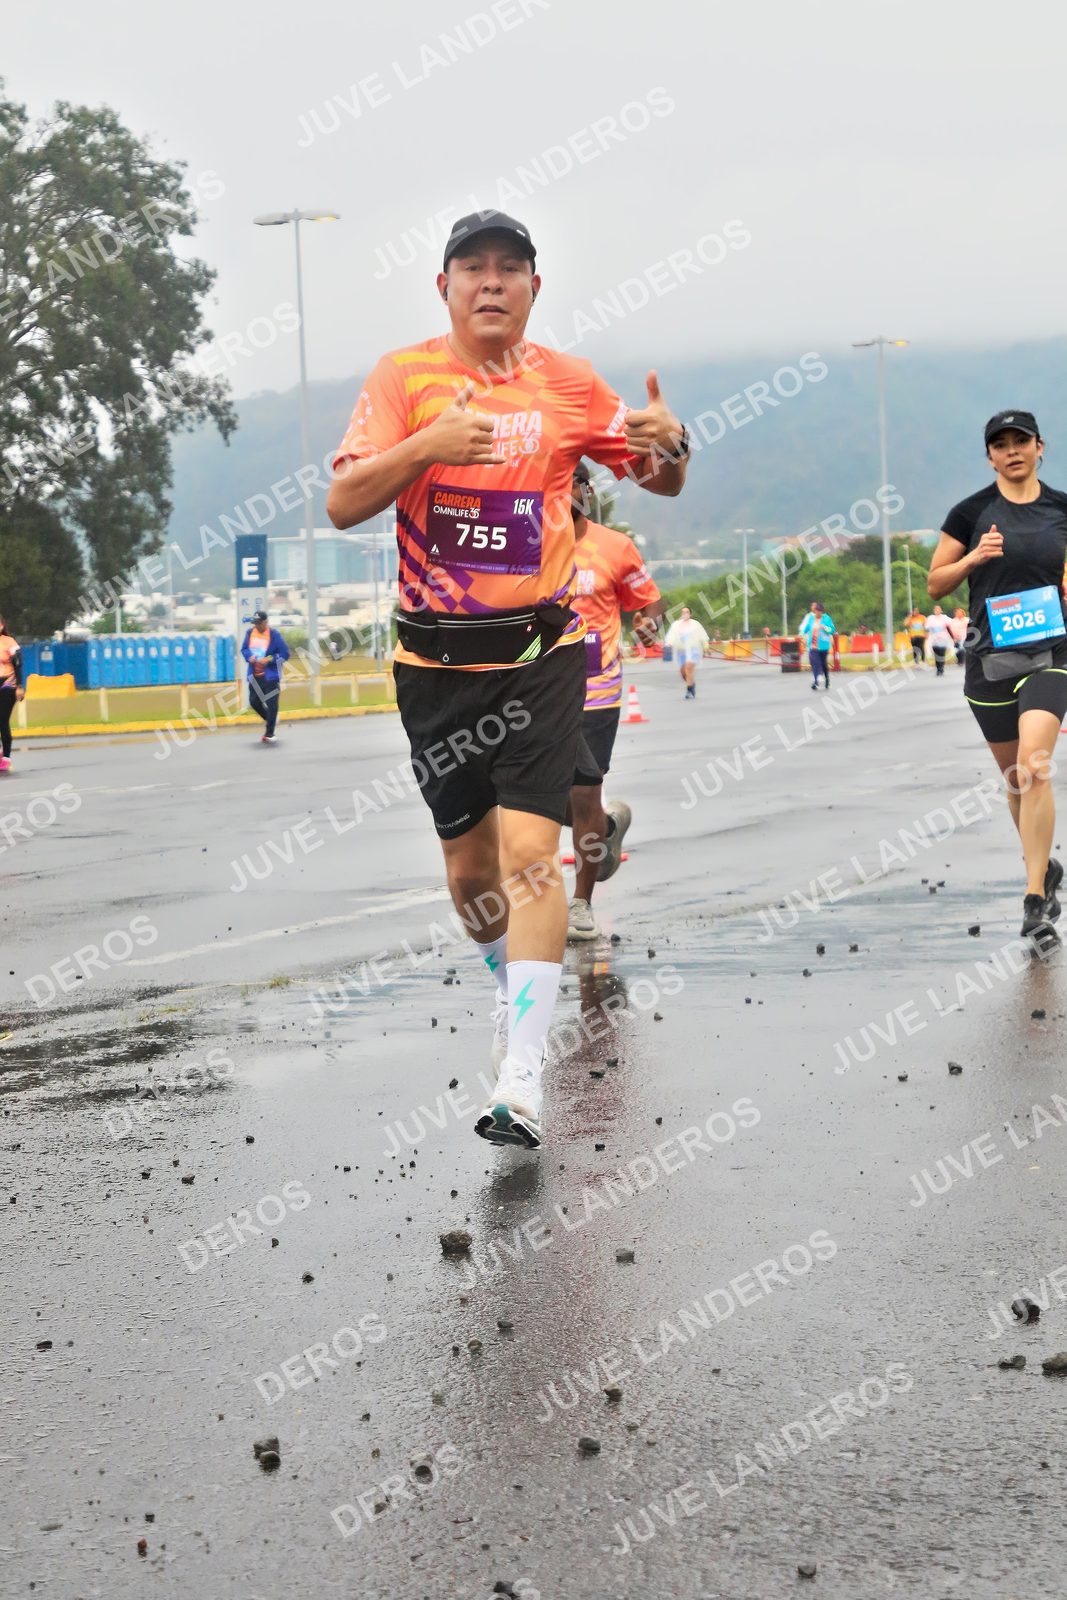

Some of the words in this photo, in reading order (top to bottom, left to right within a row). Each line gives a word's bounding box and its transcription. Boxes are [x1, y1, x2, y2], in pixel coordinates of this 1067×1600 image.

[434, 491, 482, 508] CARRERA
[456, 523, 507, 550] 755
[241, 557, 259, 581] E
[1001, 609, 1046, 632] 2026
